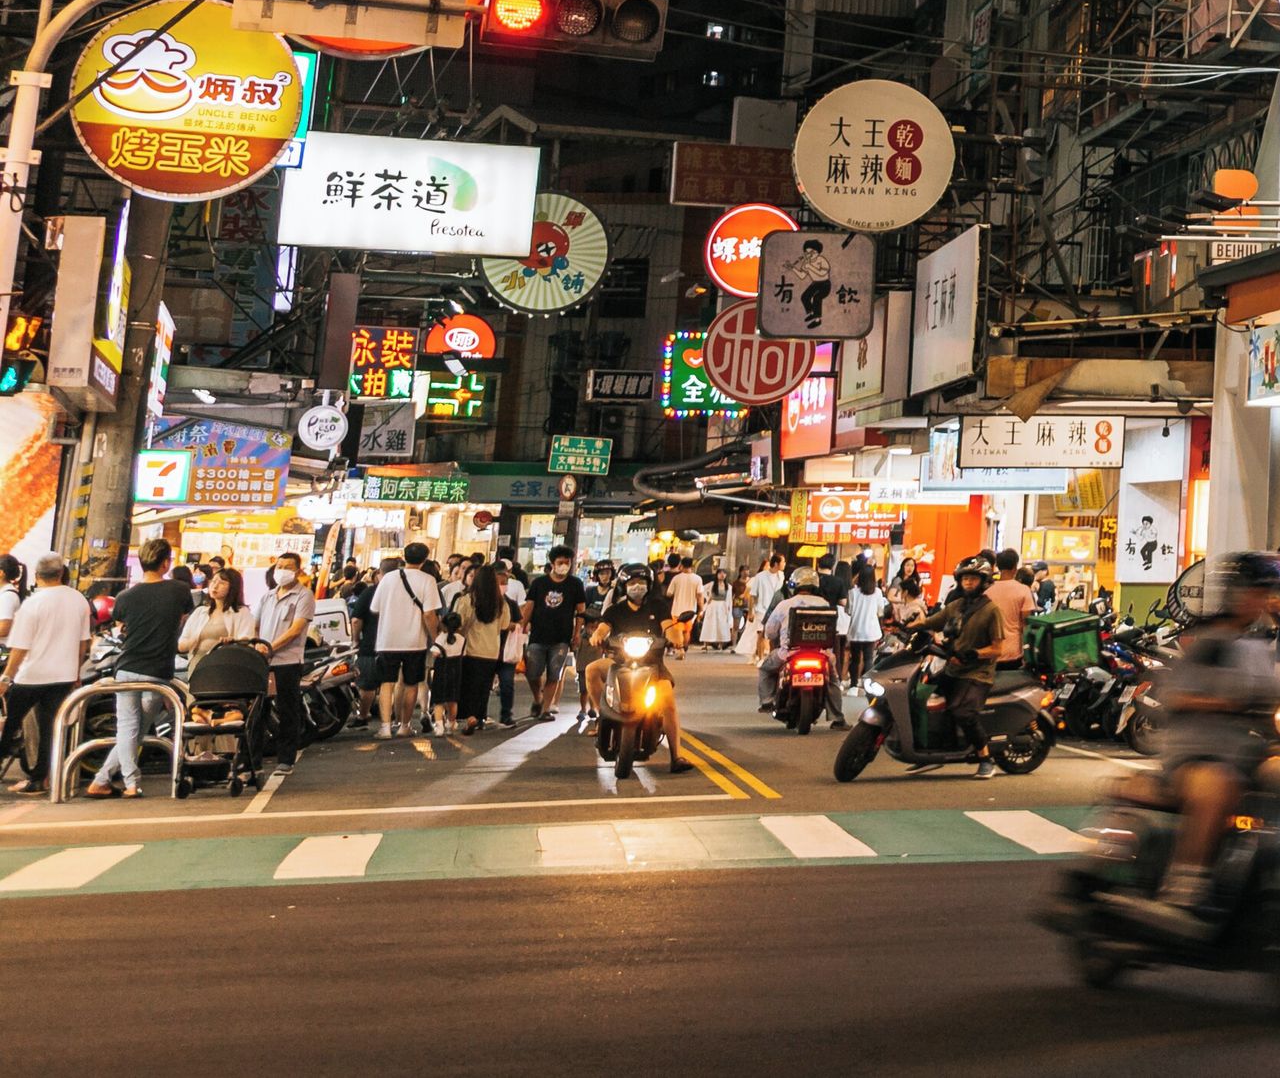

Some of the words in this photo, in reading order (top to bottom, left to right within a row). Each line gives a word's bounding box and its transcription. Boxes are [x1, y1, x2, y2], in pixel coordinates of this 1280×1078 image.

[199, 75, 279, 107] 炳叔
[198, 109, 235, 120] UNCLE
[240, 112, 278, 123] BEING
[829, 117, 885, 149] 大王
[107, 127, 252, 178] 烤玉米
[826, 153, 884, 186] 麻辣
[322, 169, 449, 214] 鮮茶道
[825, 186, 875, 196] TAIWAN
[884, 187, 918, 197] KING
[430, 219, 486, 239] Presotea
[774, 275, 794, 304] 有
[836, 284, 861, 305] 飲
[971, 419, 1088, 447] 大王麻辣
[381, 476, 468, 502] 阿宗青草茶
[802, 622, 827, 631] Uber
